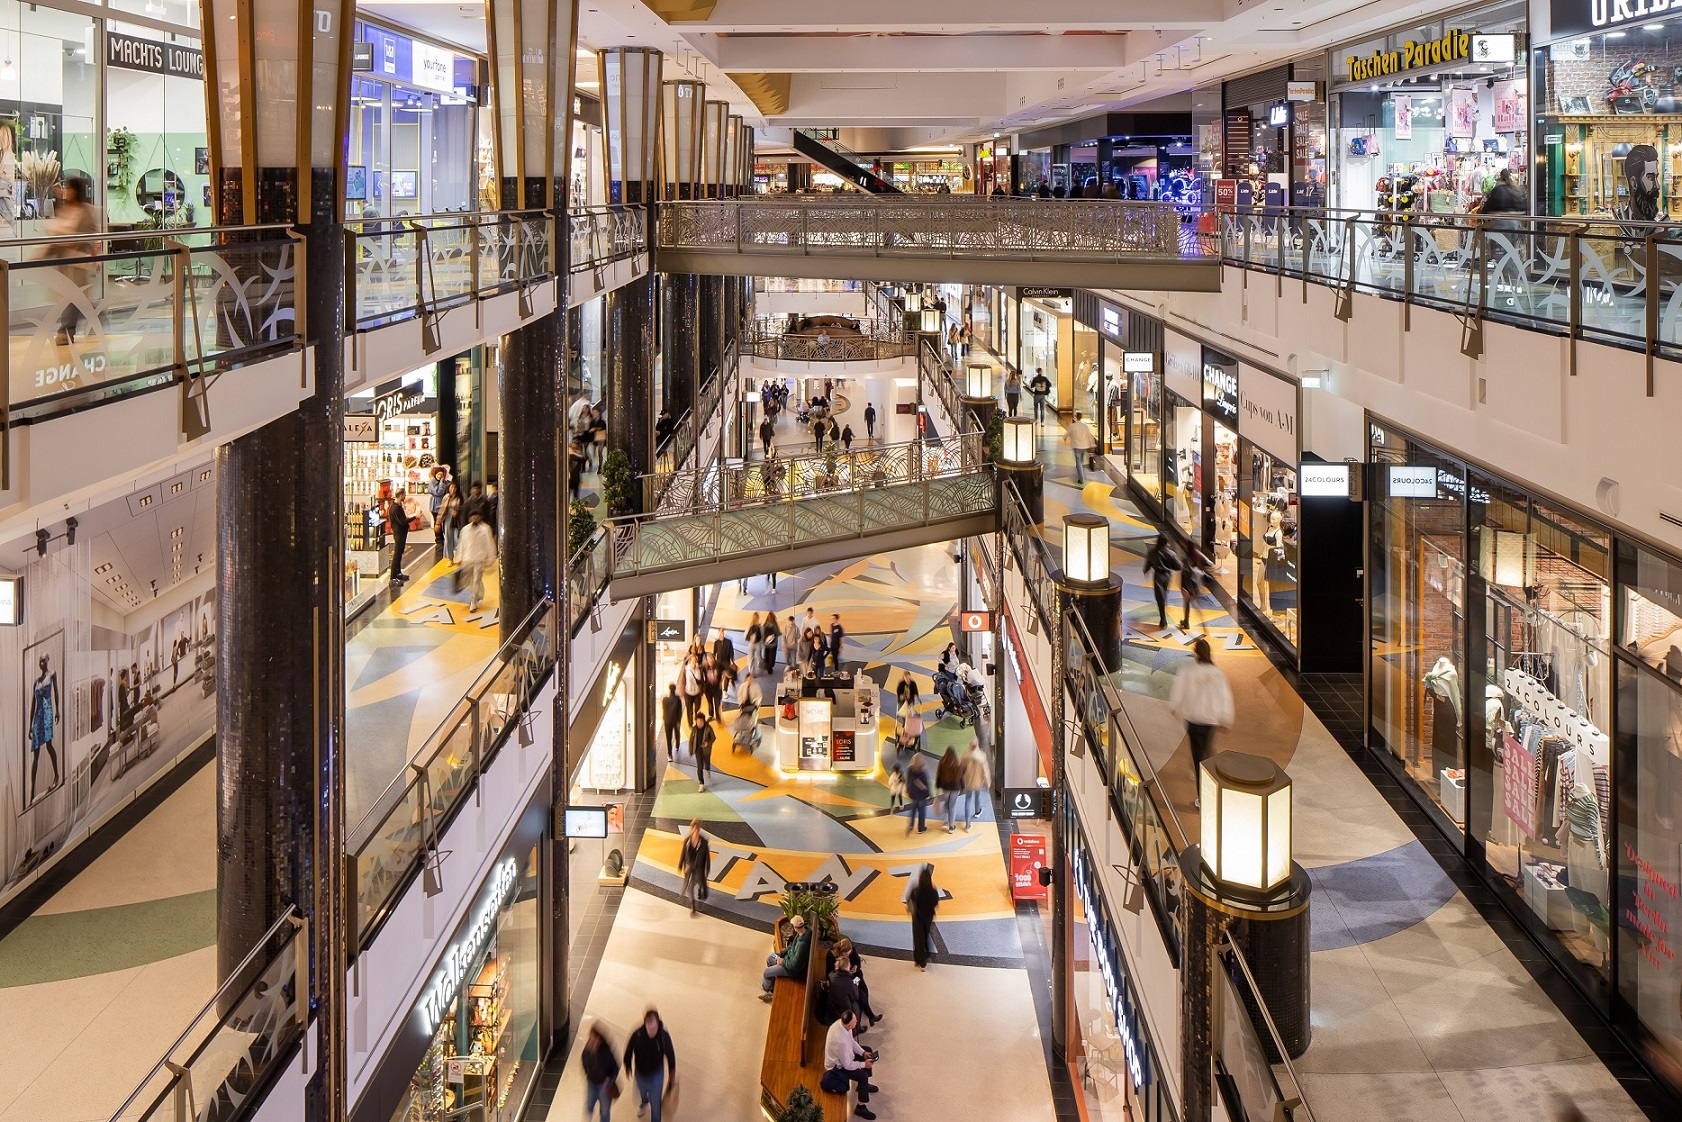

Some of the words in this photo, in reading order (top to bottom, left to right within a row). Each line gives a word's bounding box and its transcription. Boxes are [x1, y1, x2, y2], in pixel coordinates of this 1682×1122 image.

[110, 37, 163, 69] MACHTS
[168, 48, 203, 75] LOUNG
[1346, 50, 1398, 82] Taschen
[1404, 28, 1472, 69] Paradie
[1023, 287, 1043, 295] Calvin
[1043, 287, 1059, 295] Klein
[1203, 364, 1237, 396] CHANGE
[1240, 390, 1259, 420] Cups
[1260, 403, 1273, 424] von
[1506, 678, 1595, 757] 24COLOURS
[1504, 742, 1535, 778] SALE
[1504, 758, 1535, 795] SALE
[1504, 774, 1535, 813] SALE
[1504, 791, 1535, 831] SALE
